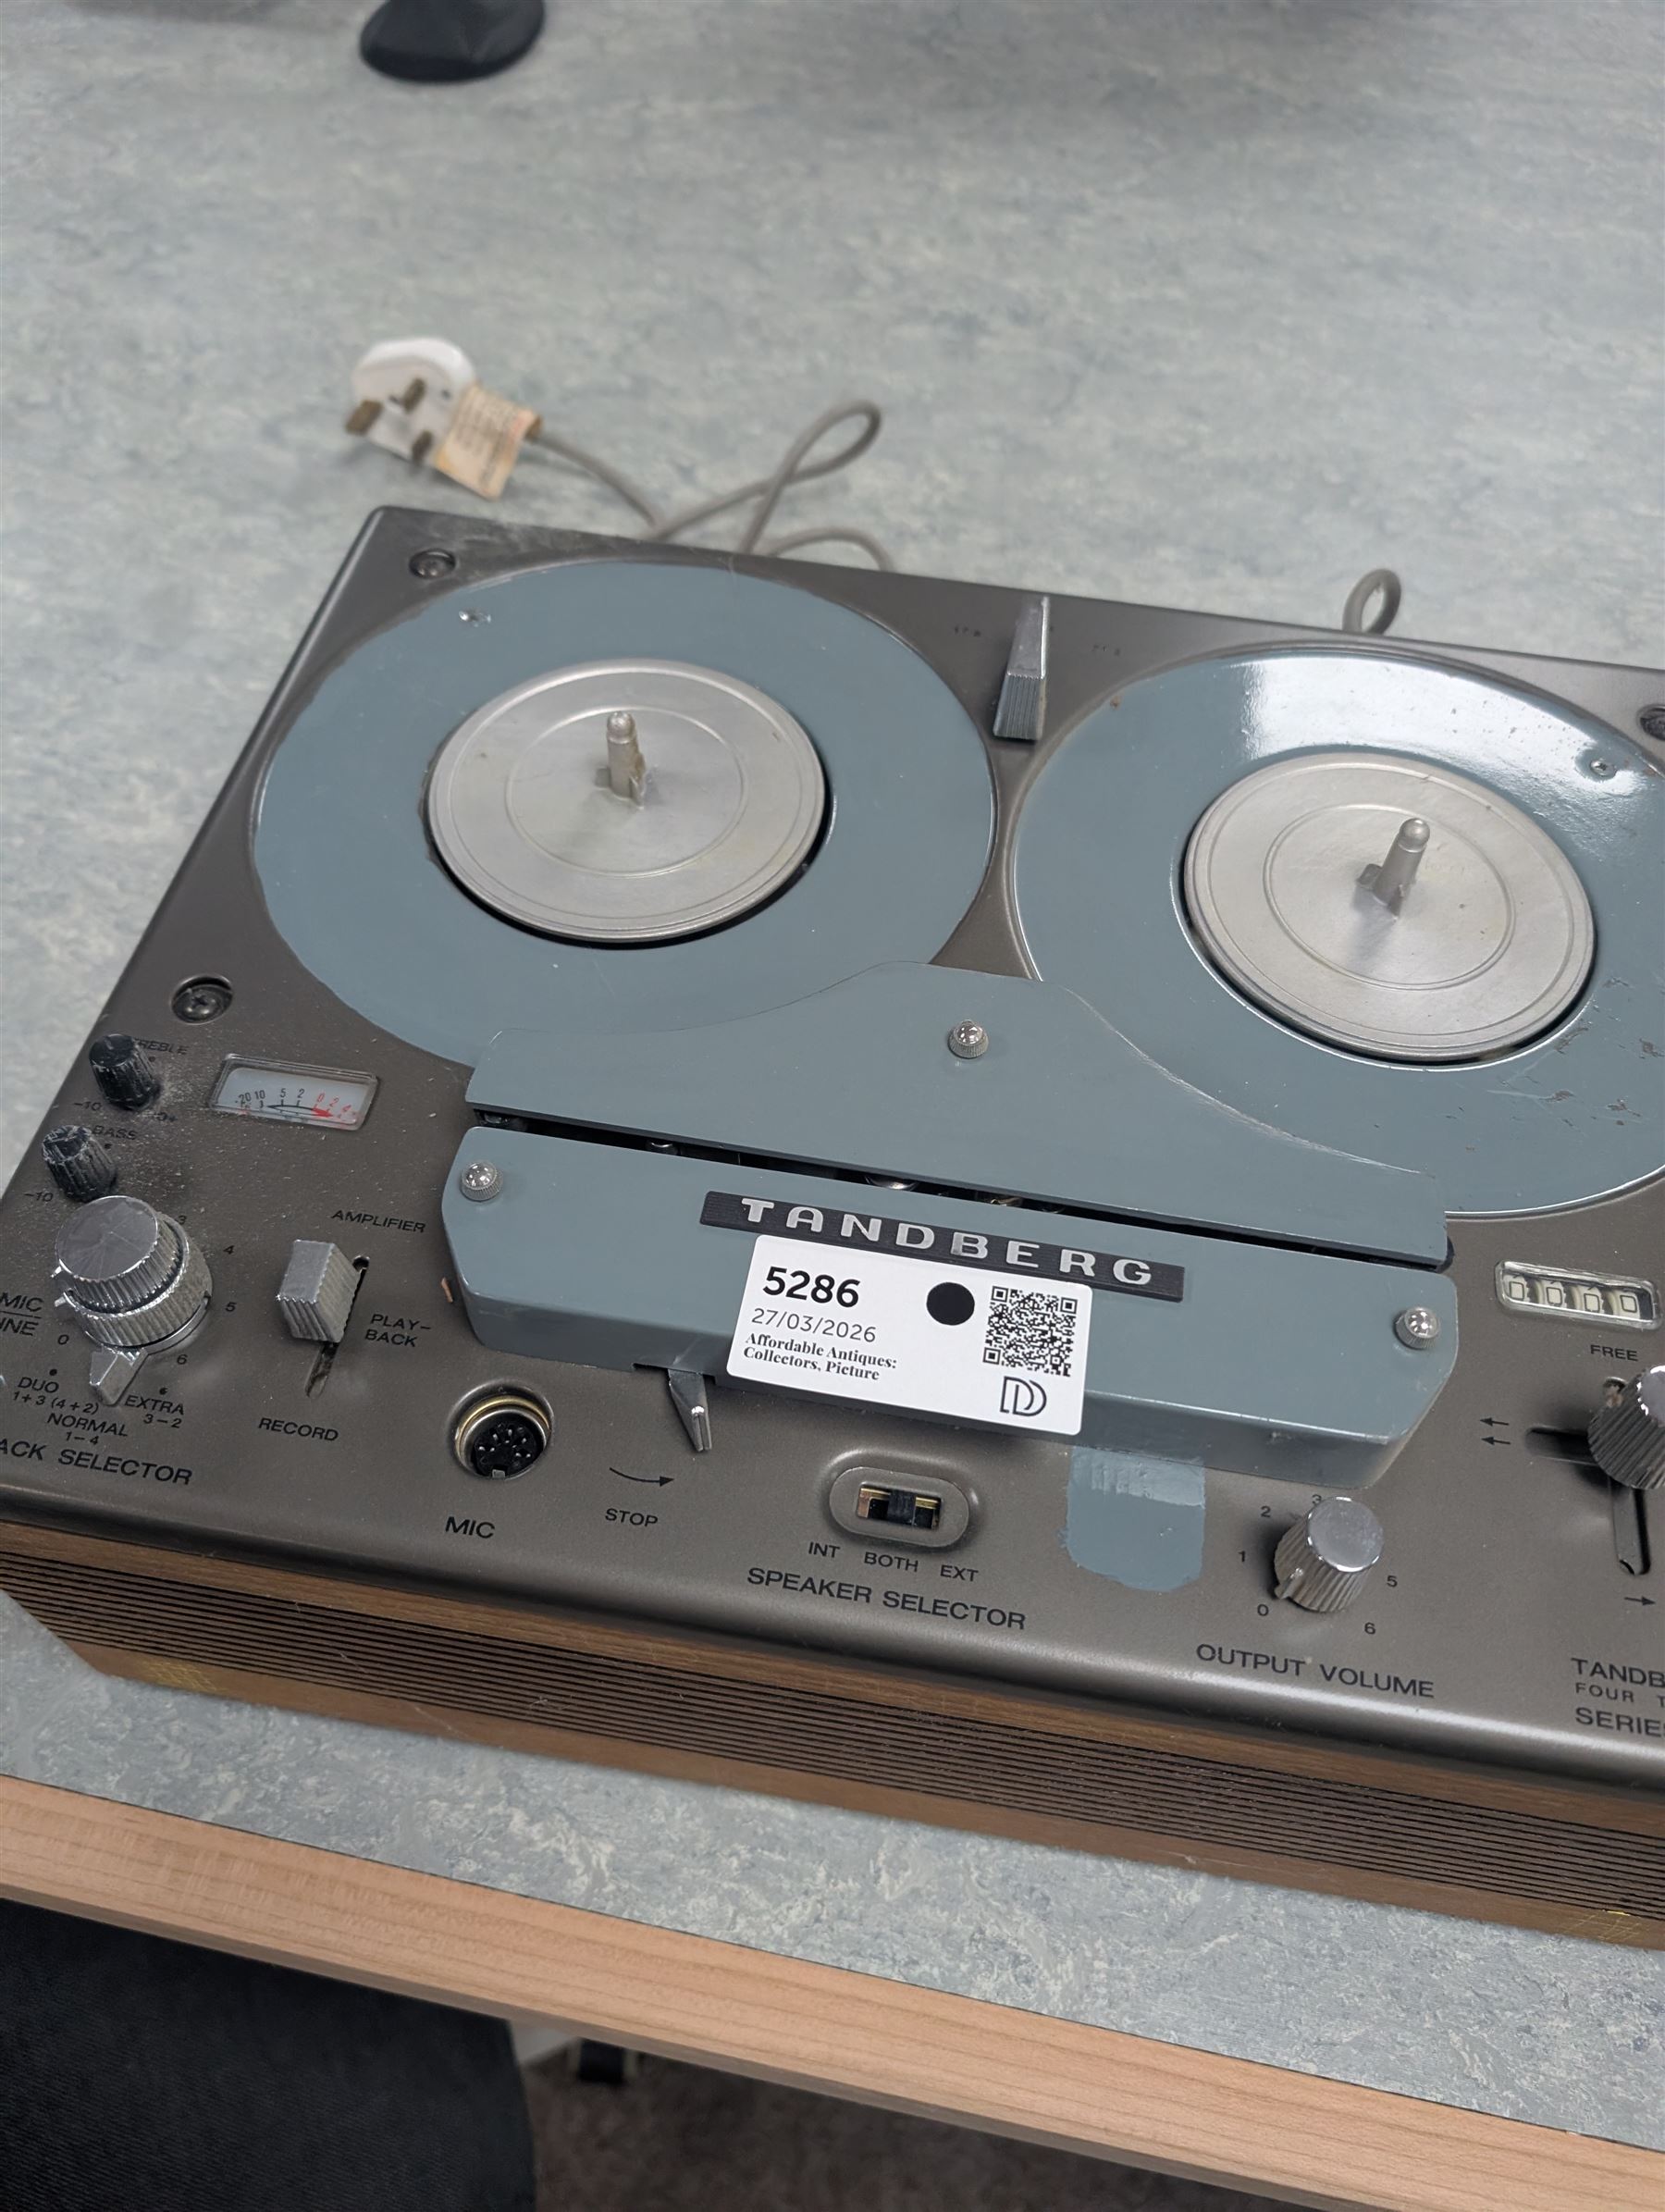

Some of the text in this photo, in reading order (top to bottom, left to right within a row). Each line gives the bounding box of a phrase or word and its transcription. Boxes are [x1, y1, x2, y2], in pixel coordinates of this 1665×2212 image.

[280, 1088, 286, 1098] 5
[298, 1088, 305, 1098] 2
[92, 1125, 138, 1140] BASS
[331, 1210, 426, 1233] AMPLIFIER
[223, 1244, 235, 1255] 4
[741, 1197, 1153, 1286] TANDBERG
[762, 1266, 861, 1308] 5286
[0, 1291, 43, 1312] MIC
[225, 1302, 236, 1313] 5
[751, 1307, 877, 1342] 27/03/2026
[365, 1328, 419, 1347] BACK
[177, 1353, 188, 1366] 6
[746, 1332, 898, 1369] Affordable Antiques:
[1590, 1344, 1639, 1362] FREE
[744, 1346, 880, 1380] Collectors, Picture
[18, 1377, 59, 1393] DUO
[125, 1395, 185, 1415] EXTRA
[47, 1413, 128, 1437] NORMAL
[258, 1417, 339, 1441] RECORD
[57, 1449, 193, 1486] SELECTOR
[605, 1508, 659, 1527] STOP
[1260, 1505, 1272, 1518] 2
[445, 1515, 496, 1539] MIC
[808, 1541, 979, 1582] INT BOTH EXT
[1238, 1551, 1248, 1563] 1
[1387, 1575, 1399, 1588] 5
[746, 1567, 1026, 1629] SPEAKER SELECTOR
[1363, 1622, 1376, 1635] 6
[1196, 1644, 1435, 1698] OUTPUT VOLUME
[1575, 1682, 1634, 1703] FOUR
[1575, 1707, 1665, 1738] SERIE
